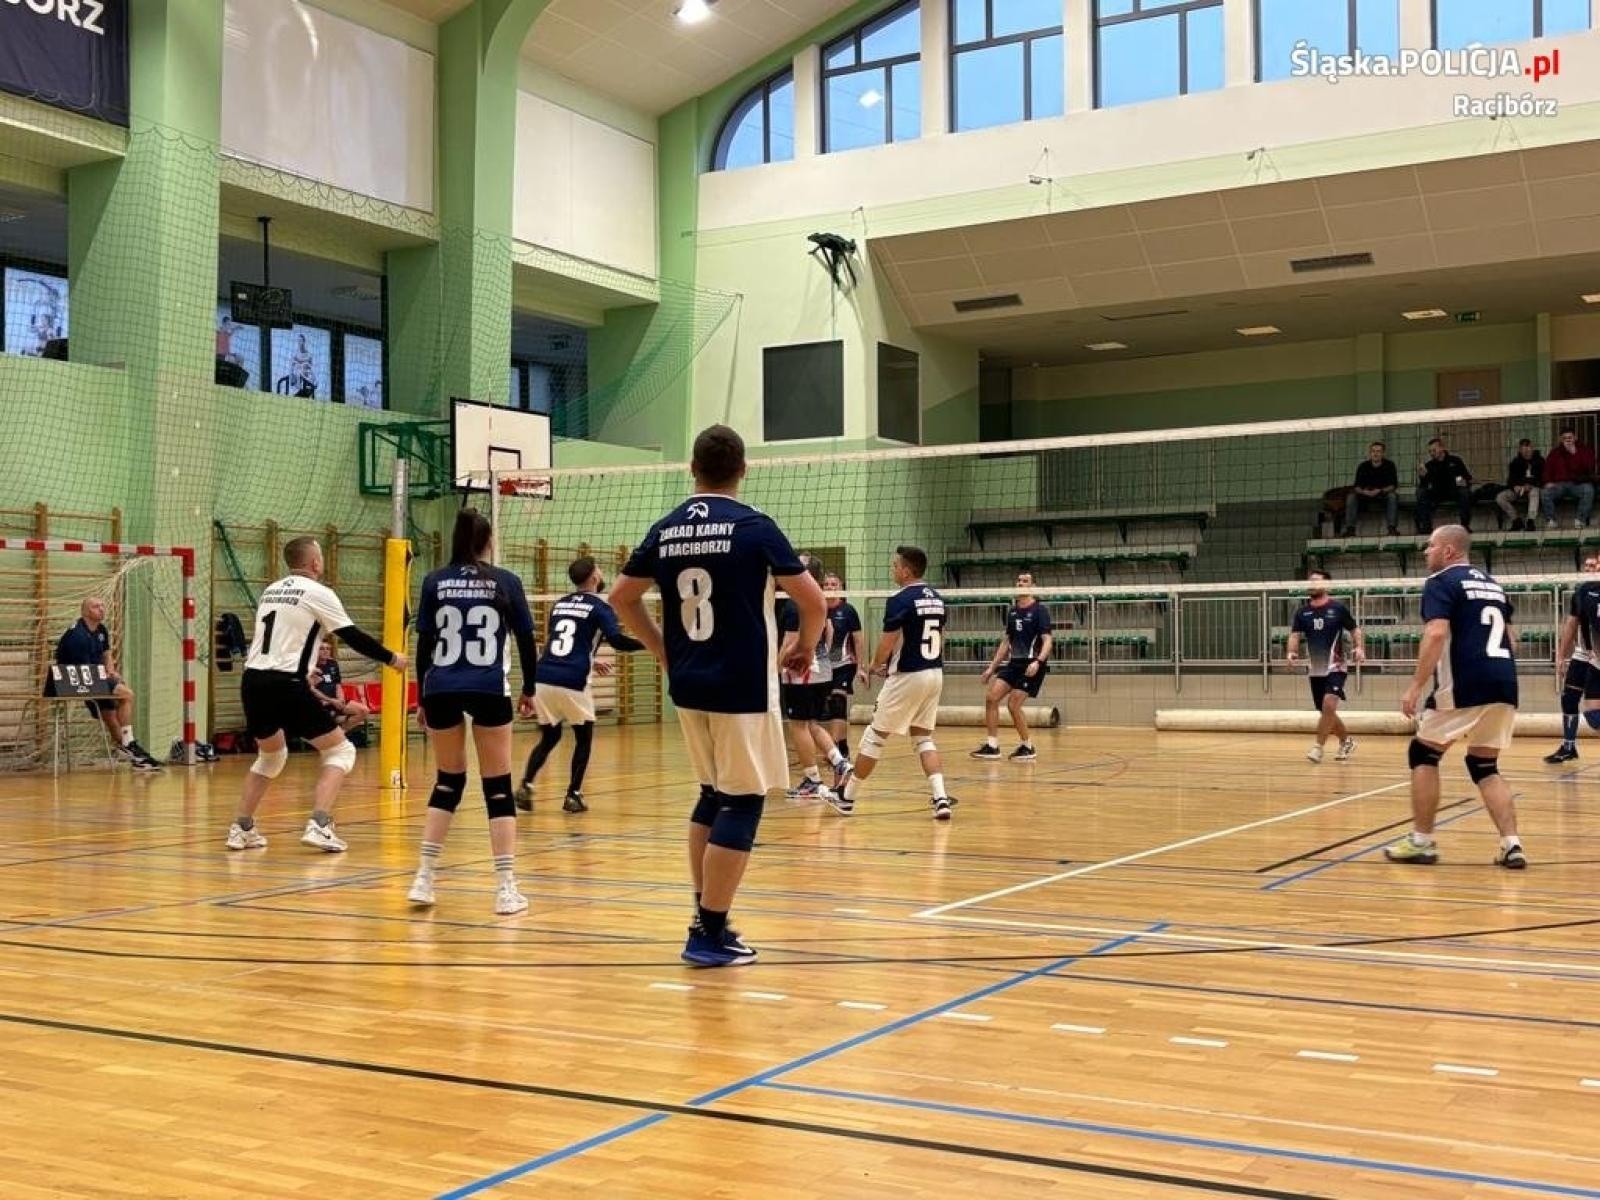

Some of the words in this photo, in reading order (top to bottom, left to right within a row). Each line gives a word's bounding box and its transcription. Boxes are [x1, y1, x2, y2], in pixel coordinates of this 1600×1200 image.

[668, 540, 732, 557] RACIBORZU
[696, 522, 735, 537] KARNY
[677, 566, 714, 641] 8
[261, 610, 276, 655] 1
[432, 604, 500, 667] 33
[550, 618, 576, 657] 3
[920, 619, 941, 660] 5
[1313, 618, 1324, 631] 10
[1480, 605, 1511, 658] 2
